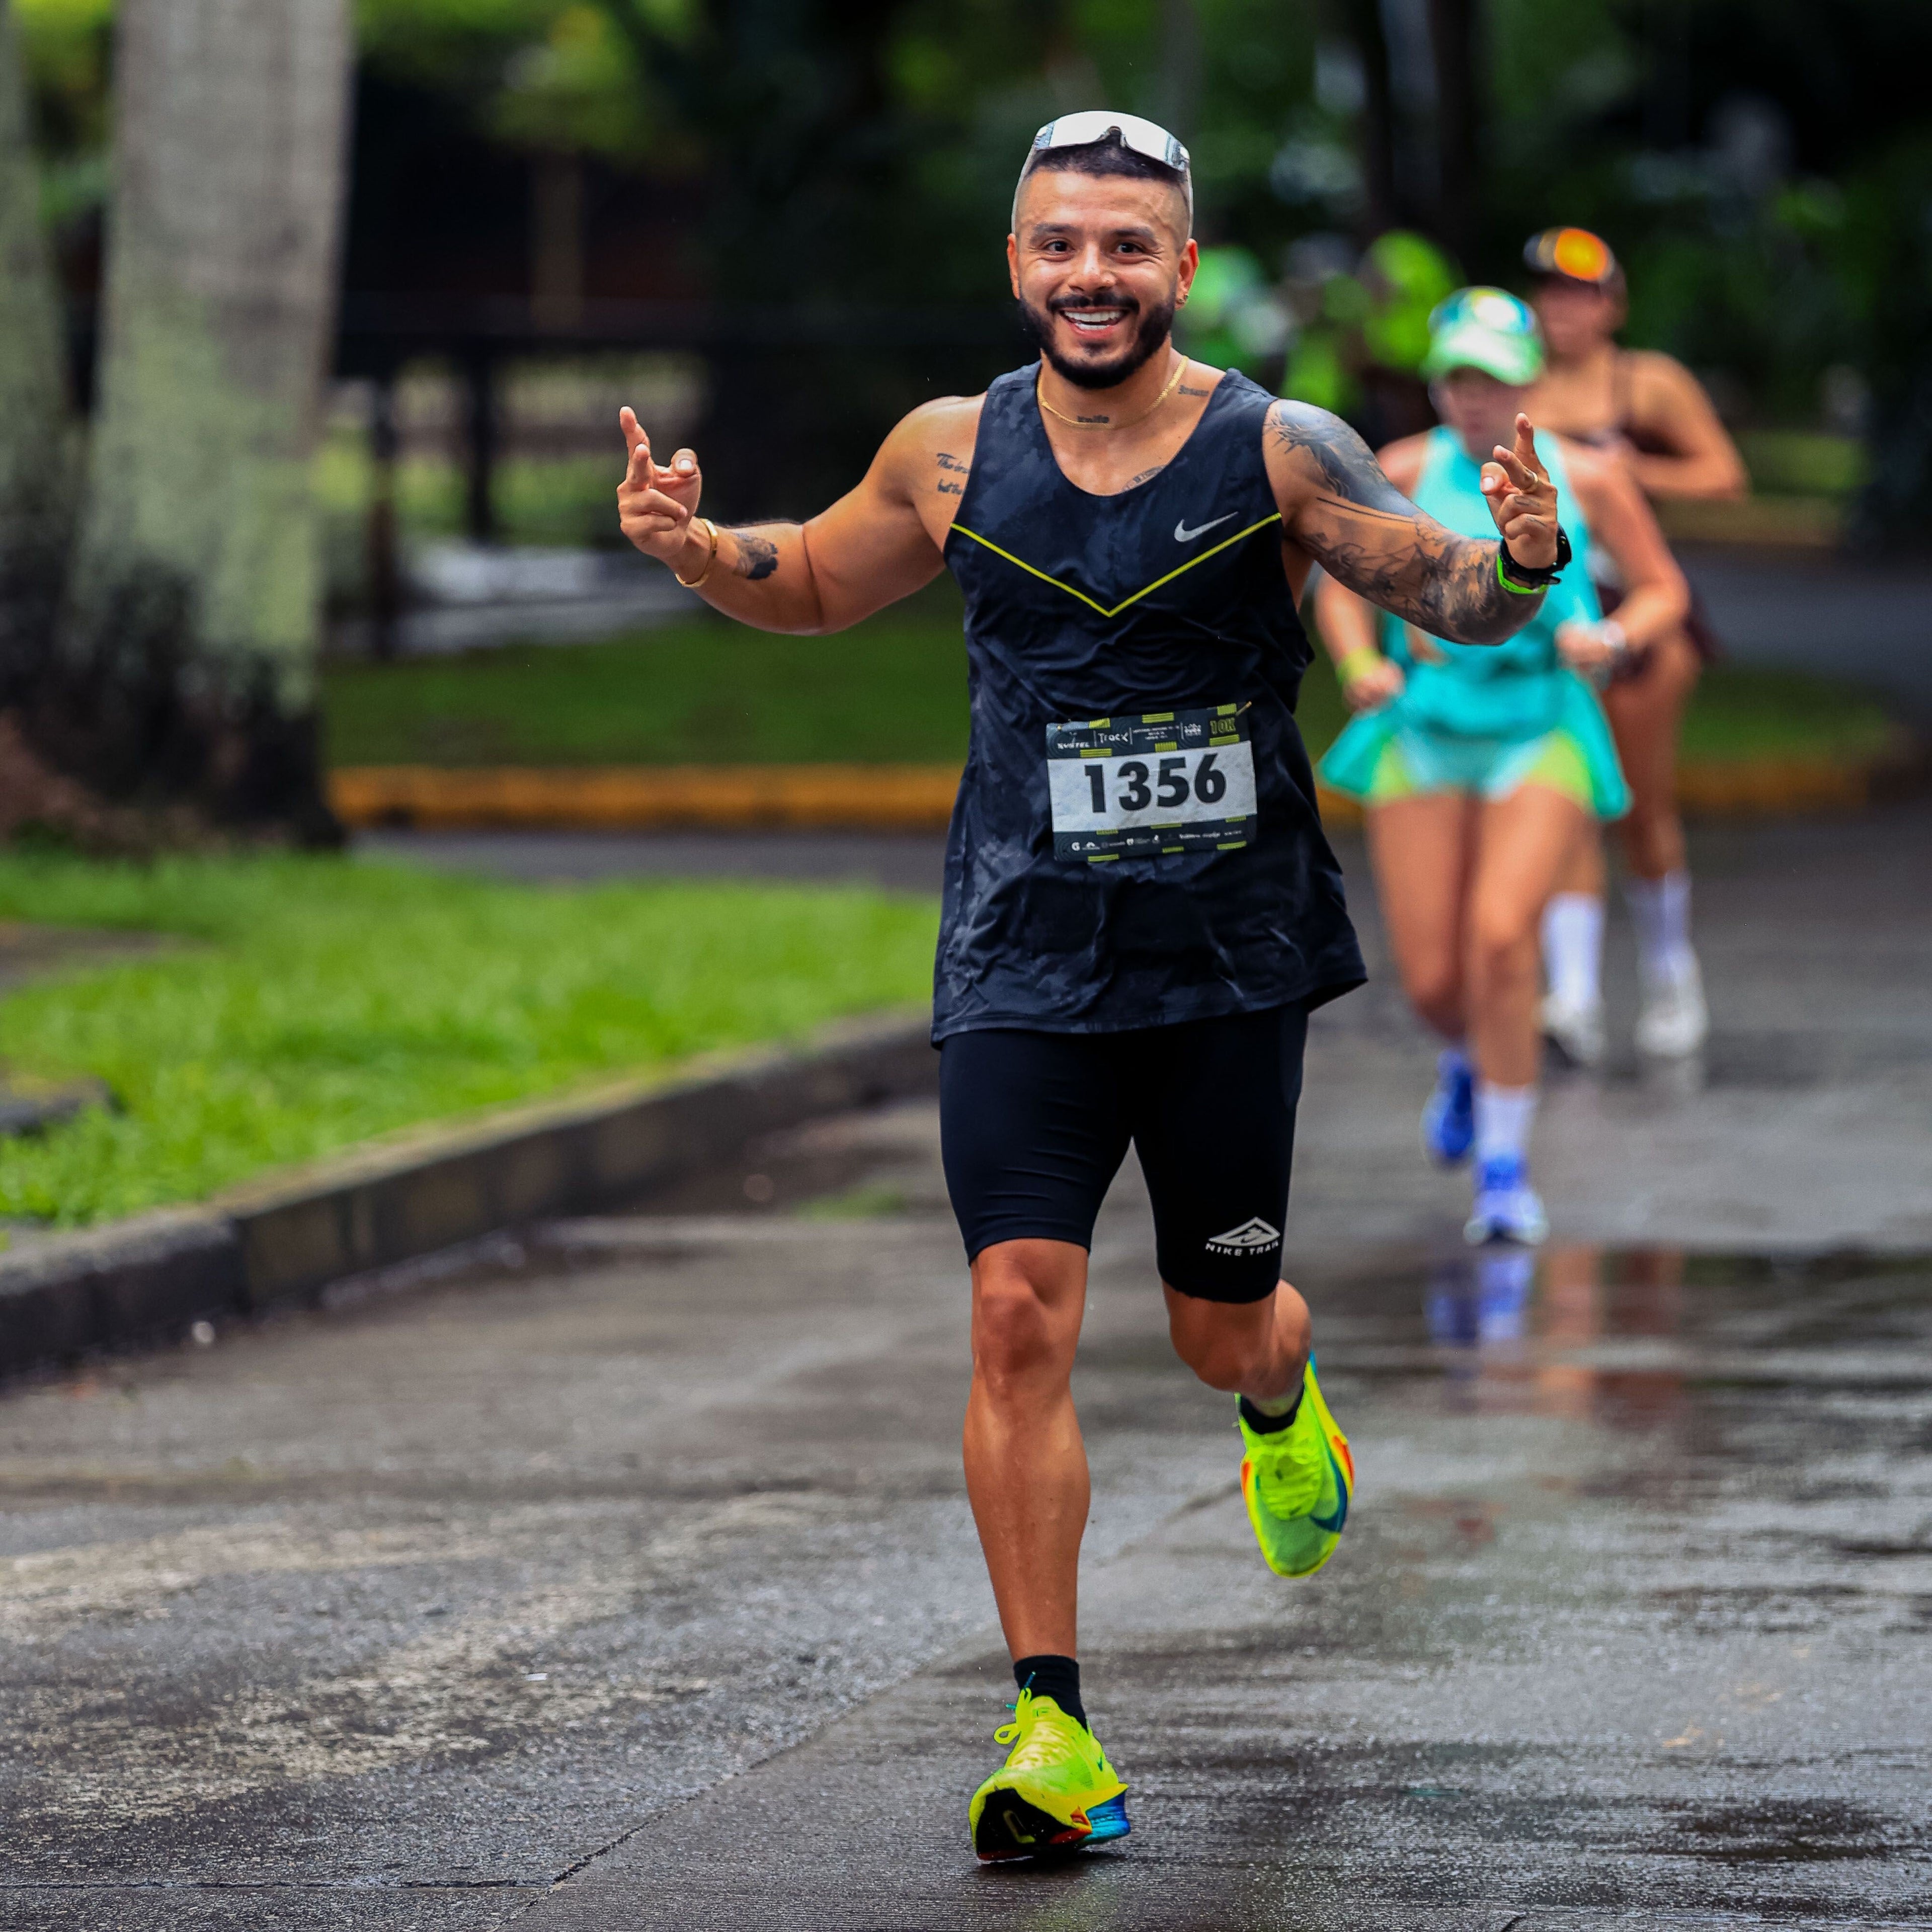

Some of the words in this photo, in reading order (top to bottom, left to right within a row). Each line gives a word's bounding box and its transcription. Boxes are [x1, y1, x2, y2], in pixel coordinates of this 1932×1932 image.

[1209, 717, 1237, 735] 10K
[1084, 753, 1227, 813] 1356
[1205, 1242, 1243, 1256] NIKE
